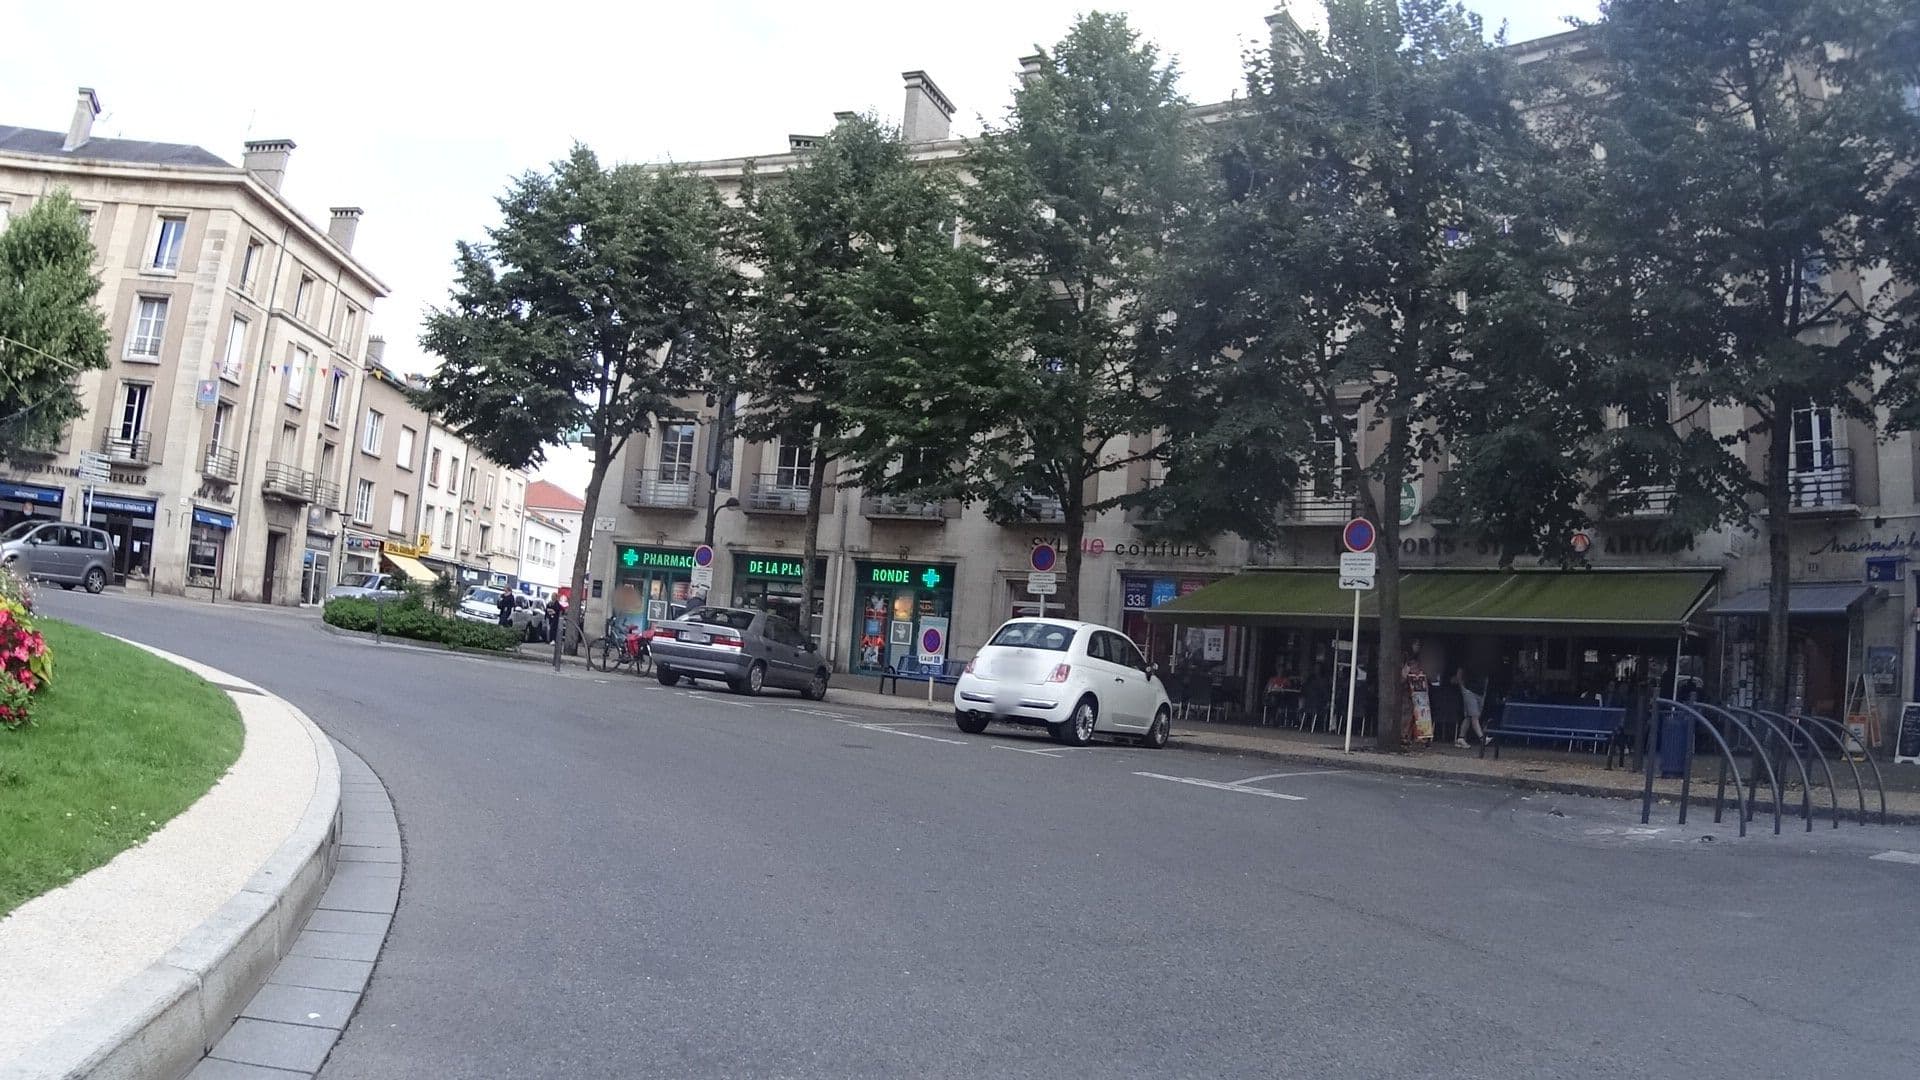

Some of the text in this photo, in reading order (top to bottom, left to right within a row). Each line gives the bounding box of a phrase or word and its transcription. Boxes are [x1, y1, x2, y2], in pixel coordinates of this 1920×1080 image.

[643, 552, 697, 568] PHARMACI
[750, 561, 804, 577] DE LA PLA
[872, 568, 910, 583] RONDE
